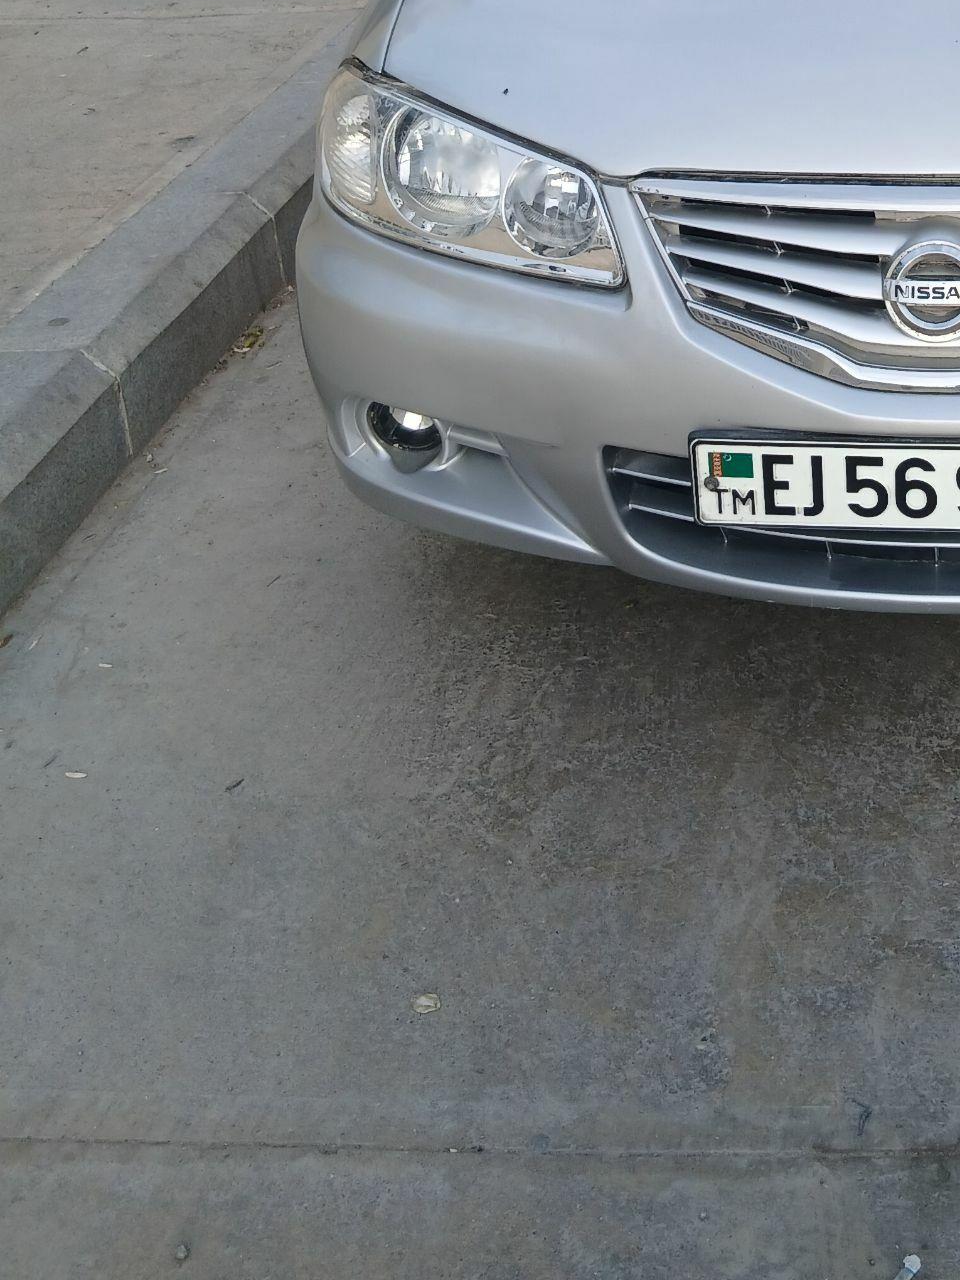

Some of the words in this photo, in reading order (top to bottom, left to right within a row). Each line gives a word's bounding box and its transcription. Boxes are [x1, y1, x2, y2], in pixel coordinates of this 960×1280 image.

[710, 488, 756, 516] TM
[762, 454, 824, 516] EJ
[845, 456, 938, 519] 56
